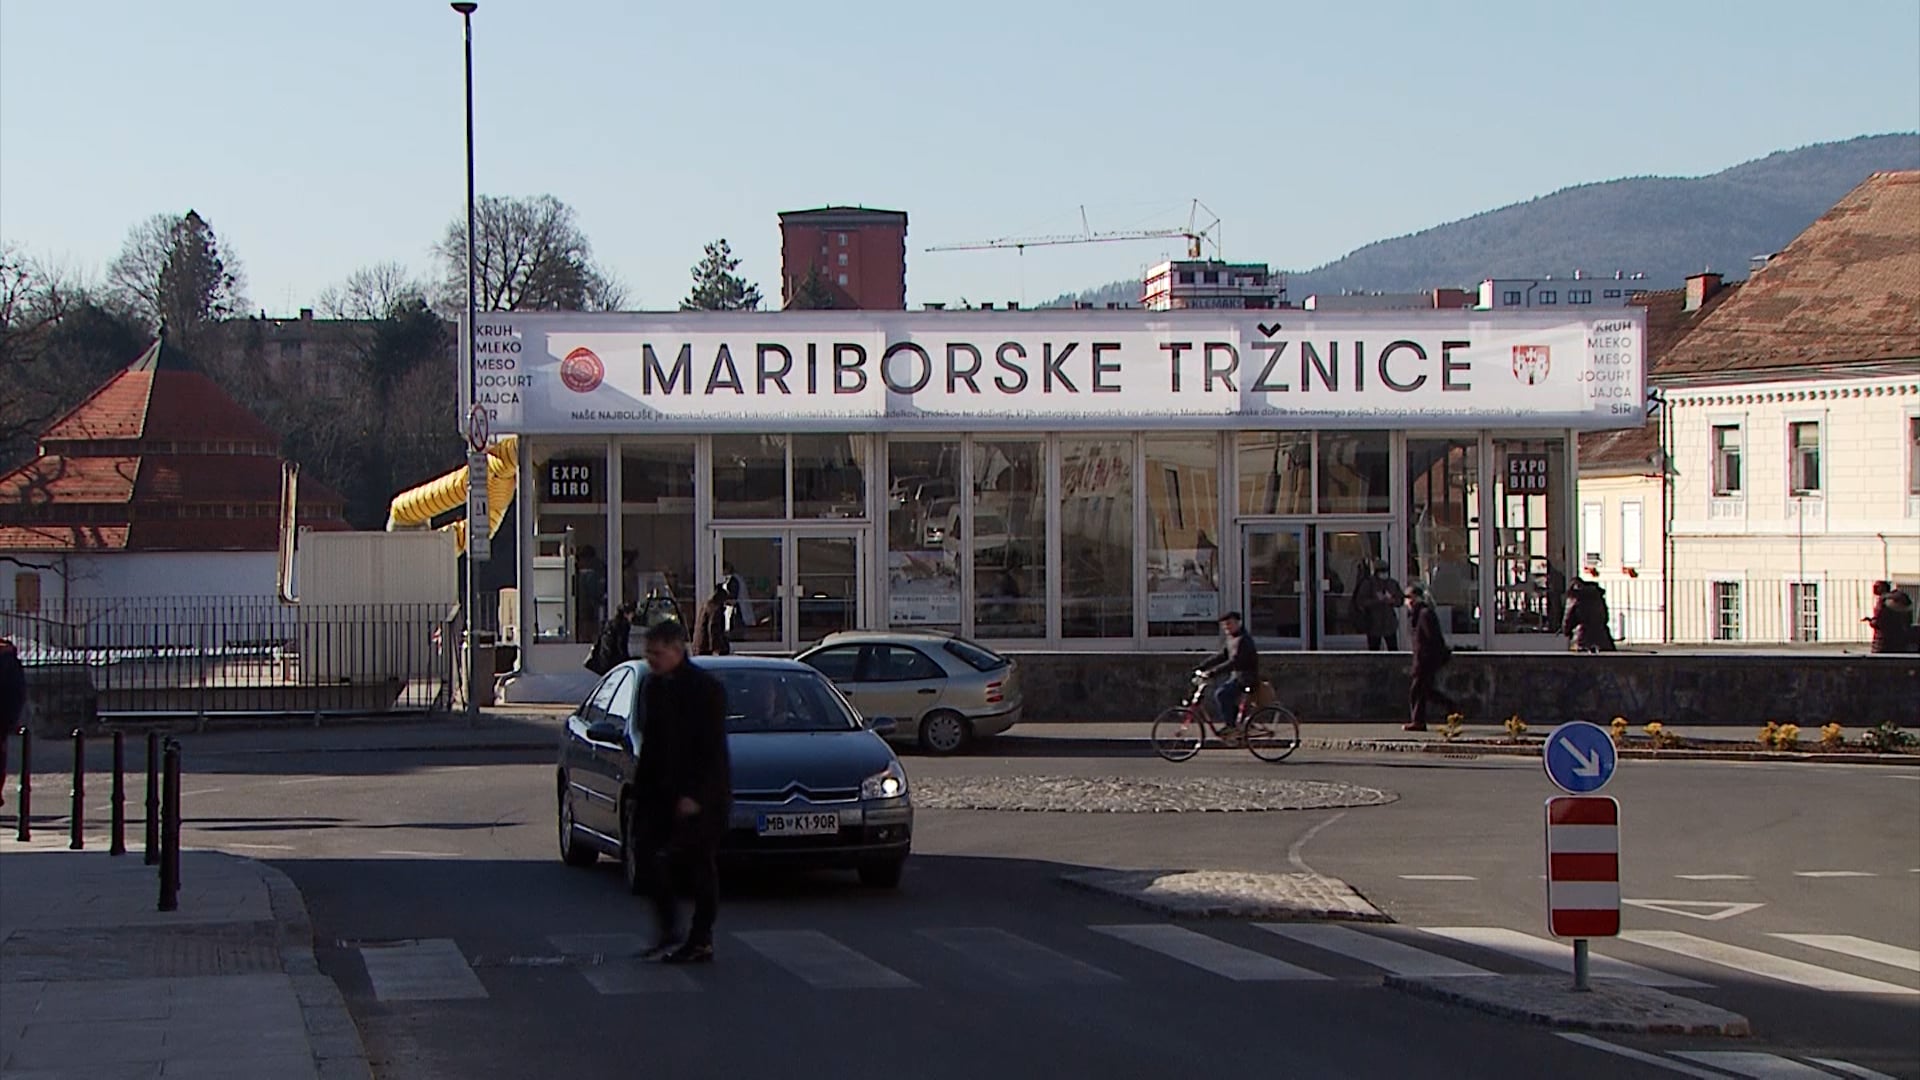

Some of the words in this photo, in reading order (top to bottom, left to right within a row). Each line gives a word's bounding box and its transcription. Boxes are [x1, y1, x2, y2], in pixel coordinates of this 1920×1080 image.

[476, 325, 512, 336] KRUH
[1595, 322, 1631, 331] KRUH
[476, 341, 522, 353] MLEKO
[1587, 337, 1632, 348] MLEKO
[476, 359, 515, 370] MESO
[643, 341, 1122, 395] MARIBORSKE
[1160, 323, 1471, 394] TRŽNICE
[1593, 353, 1631, 365] MESO
[476, 375, 533, 387] JOGURT
[1577, 370, 1631, 382] JOGURT
[476, 392, 520, 404] JAJCA
[1590, 387, 1631, 398] JAJCA
[571, 408, 596, 420] NAŠE
[599, 408, 653, 420] NAJBOLJŠE
[1611, 404, 1631, 414] SIR
[1510, 460, 1546, 473] EXPO
[552, 466, 589, 480] EXPO
[552, 481, 589, 495] BIRO
[1510, 475, 1546, 489] BIRO
[766, 816, 785, 830] MB
